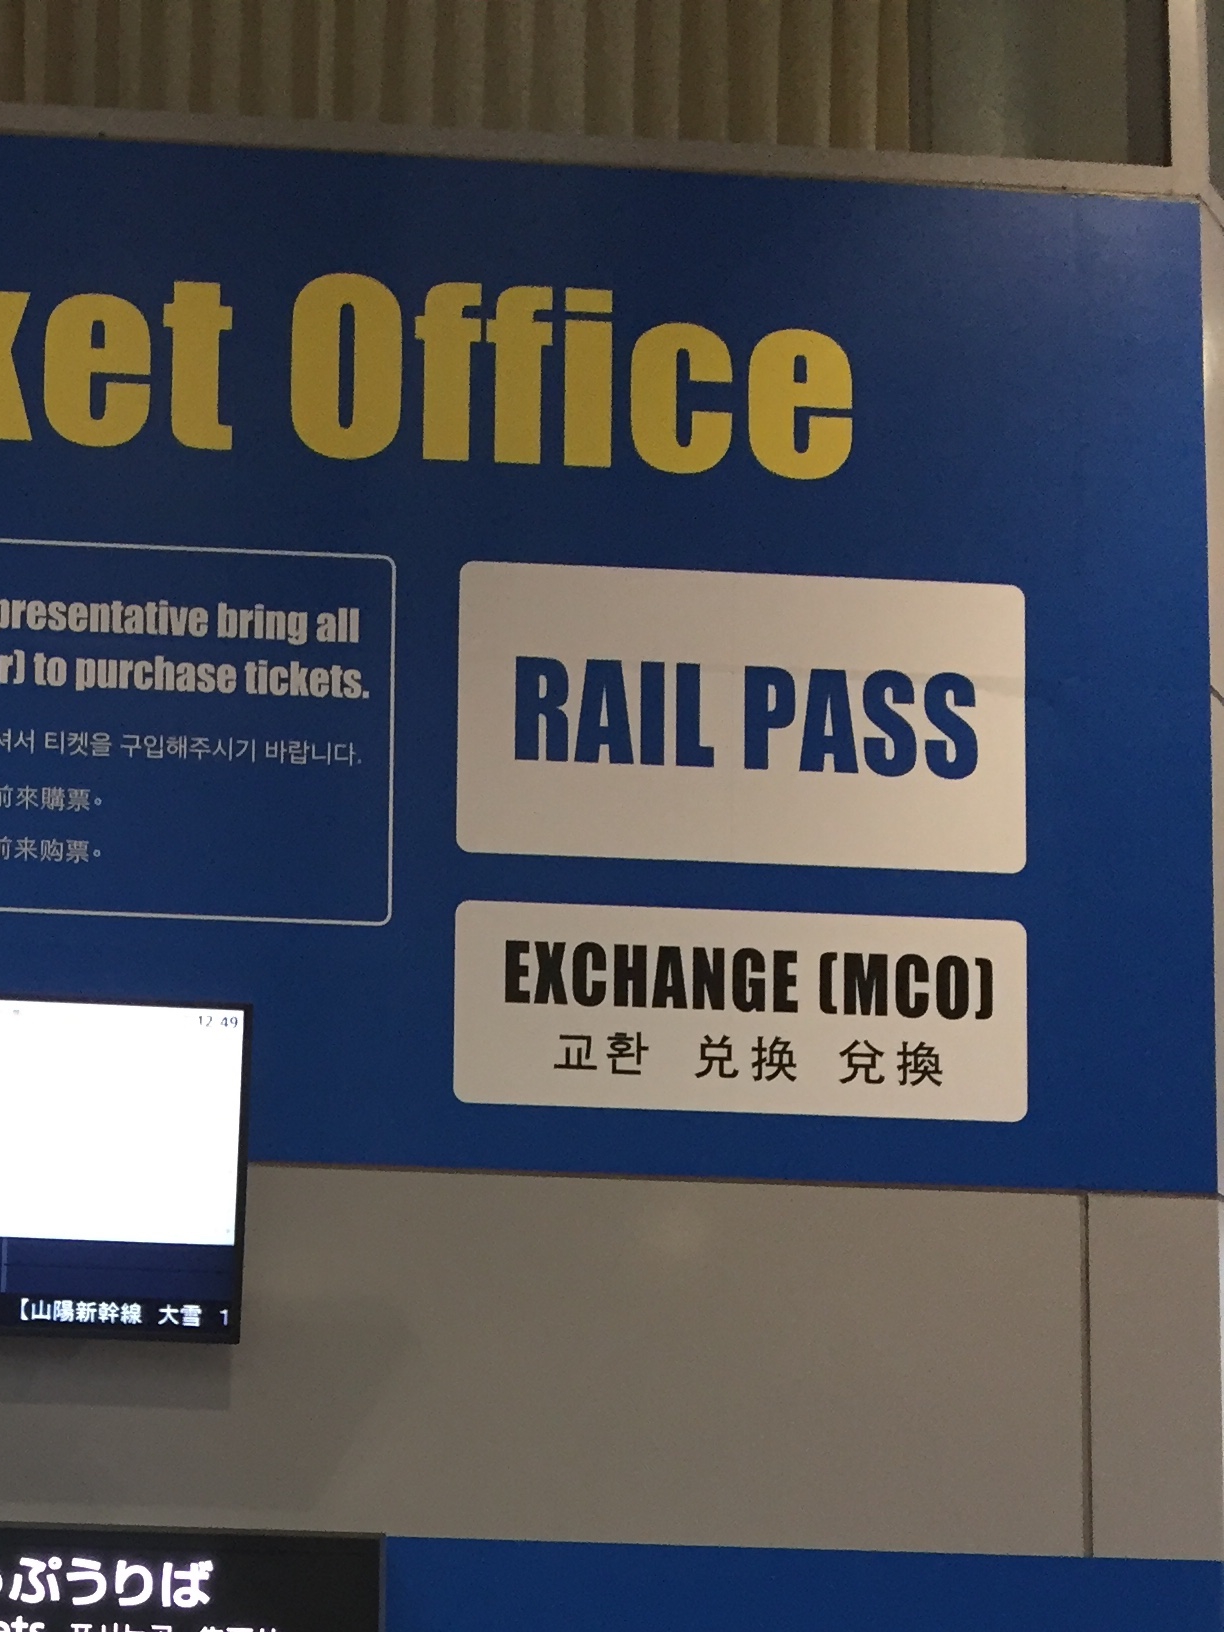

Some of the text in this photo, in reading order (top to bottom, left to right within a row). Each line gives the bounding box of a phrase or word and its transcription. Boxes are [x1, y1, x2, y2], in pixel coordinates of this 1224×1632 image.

[290, 272, 853, 479] Office
[217, 601, 308, 650] bring
[316, 607, 359, 644] all
[34, 652, 68, 687] to
[75, 655, 238, 695] purchase
[244, 660, 370, 699] tickets.
[514, 655, 978, 780] RAIL PASS
[44, 730, 112, 758] 티켓을
[120, 733, 256, 763] 구입해주시기
[264, 739, 362, 767] 바랍니다.
[504, 939, 994, 1021] EXCHANGE (MCO)
[553, 1030, 650, 1076] 교환
[694, 1035, 797, 1082] 兑换
